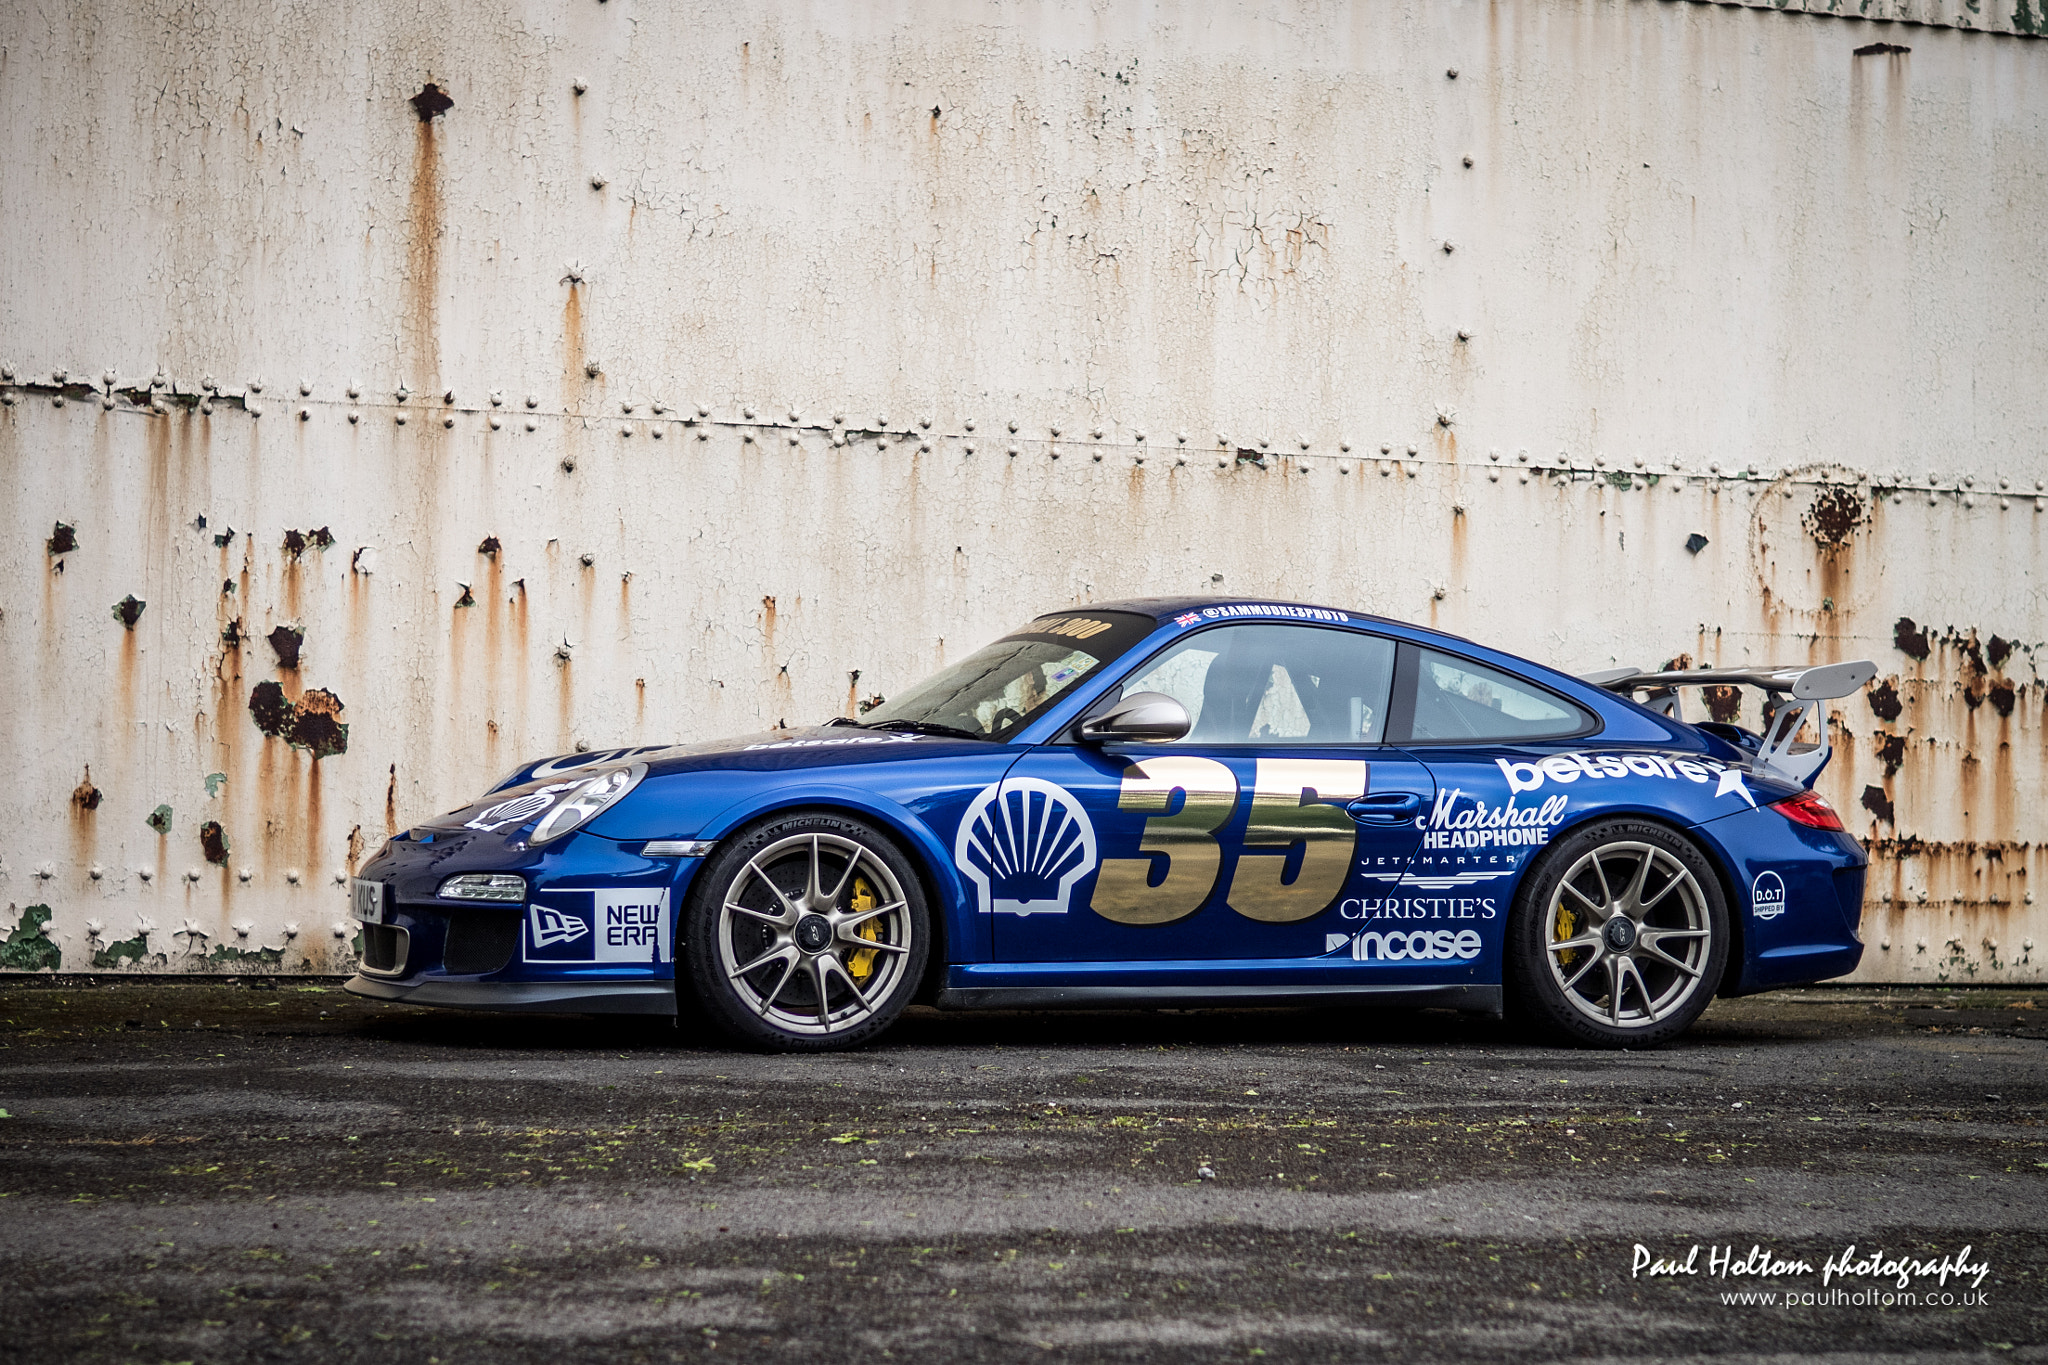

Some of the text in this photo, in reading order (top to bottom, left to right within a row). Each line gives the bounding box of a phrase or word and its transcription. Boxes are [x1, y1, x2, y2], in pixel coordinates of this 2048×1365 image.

[1415, 788, 1569, 830] Marshall
[1090, 756, 1367, 924] 35
[1424, 828, 1550, 849] HEADPHONE
[1627, 823, 1682, 848] MICHELIN
[1361, 854, 1516, 865] JETSMARTER
[357, 884, 378, 917] KUS
[1340, 898, 1496, 920] CHRISTIE'S
[607, 905, 659, 925] NEW
[607, 926, 658, 946] ERA
[1352, 930, 1482, 960] incase
